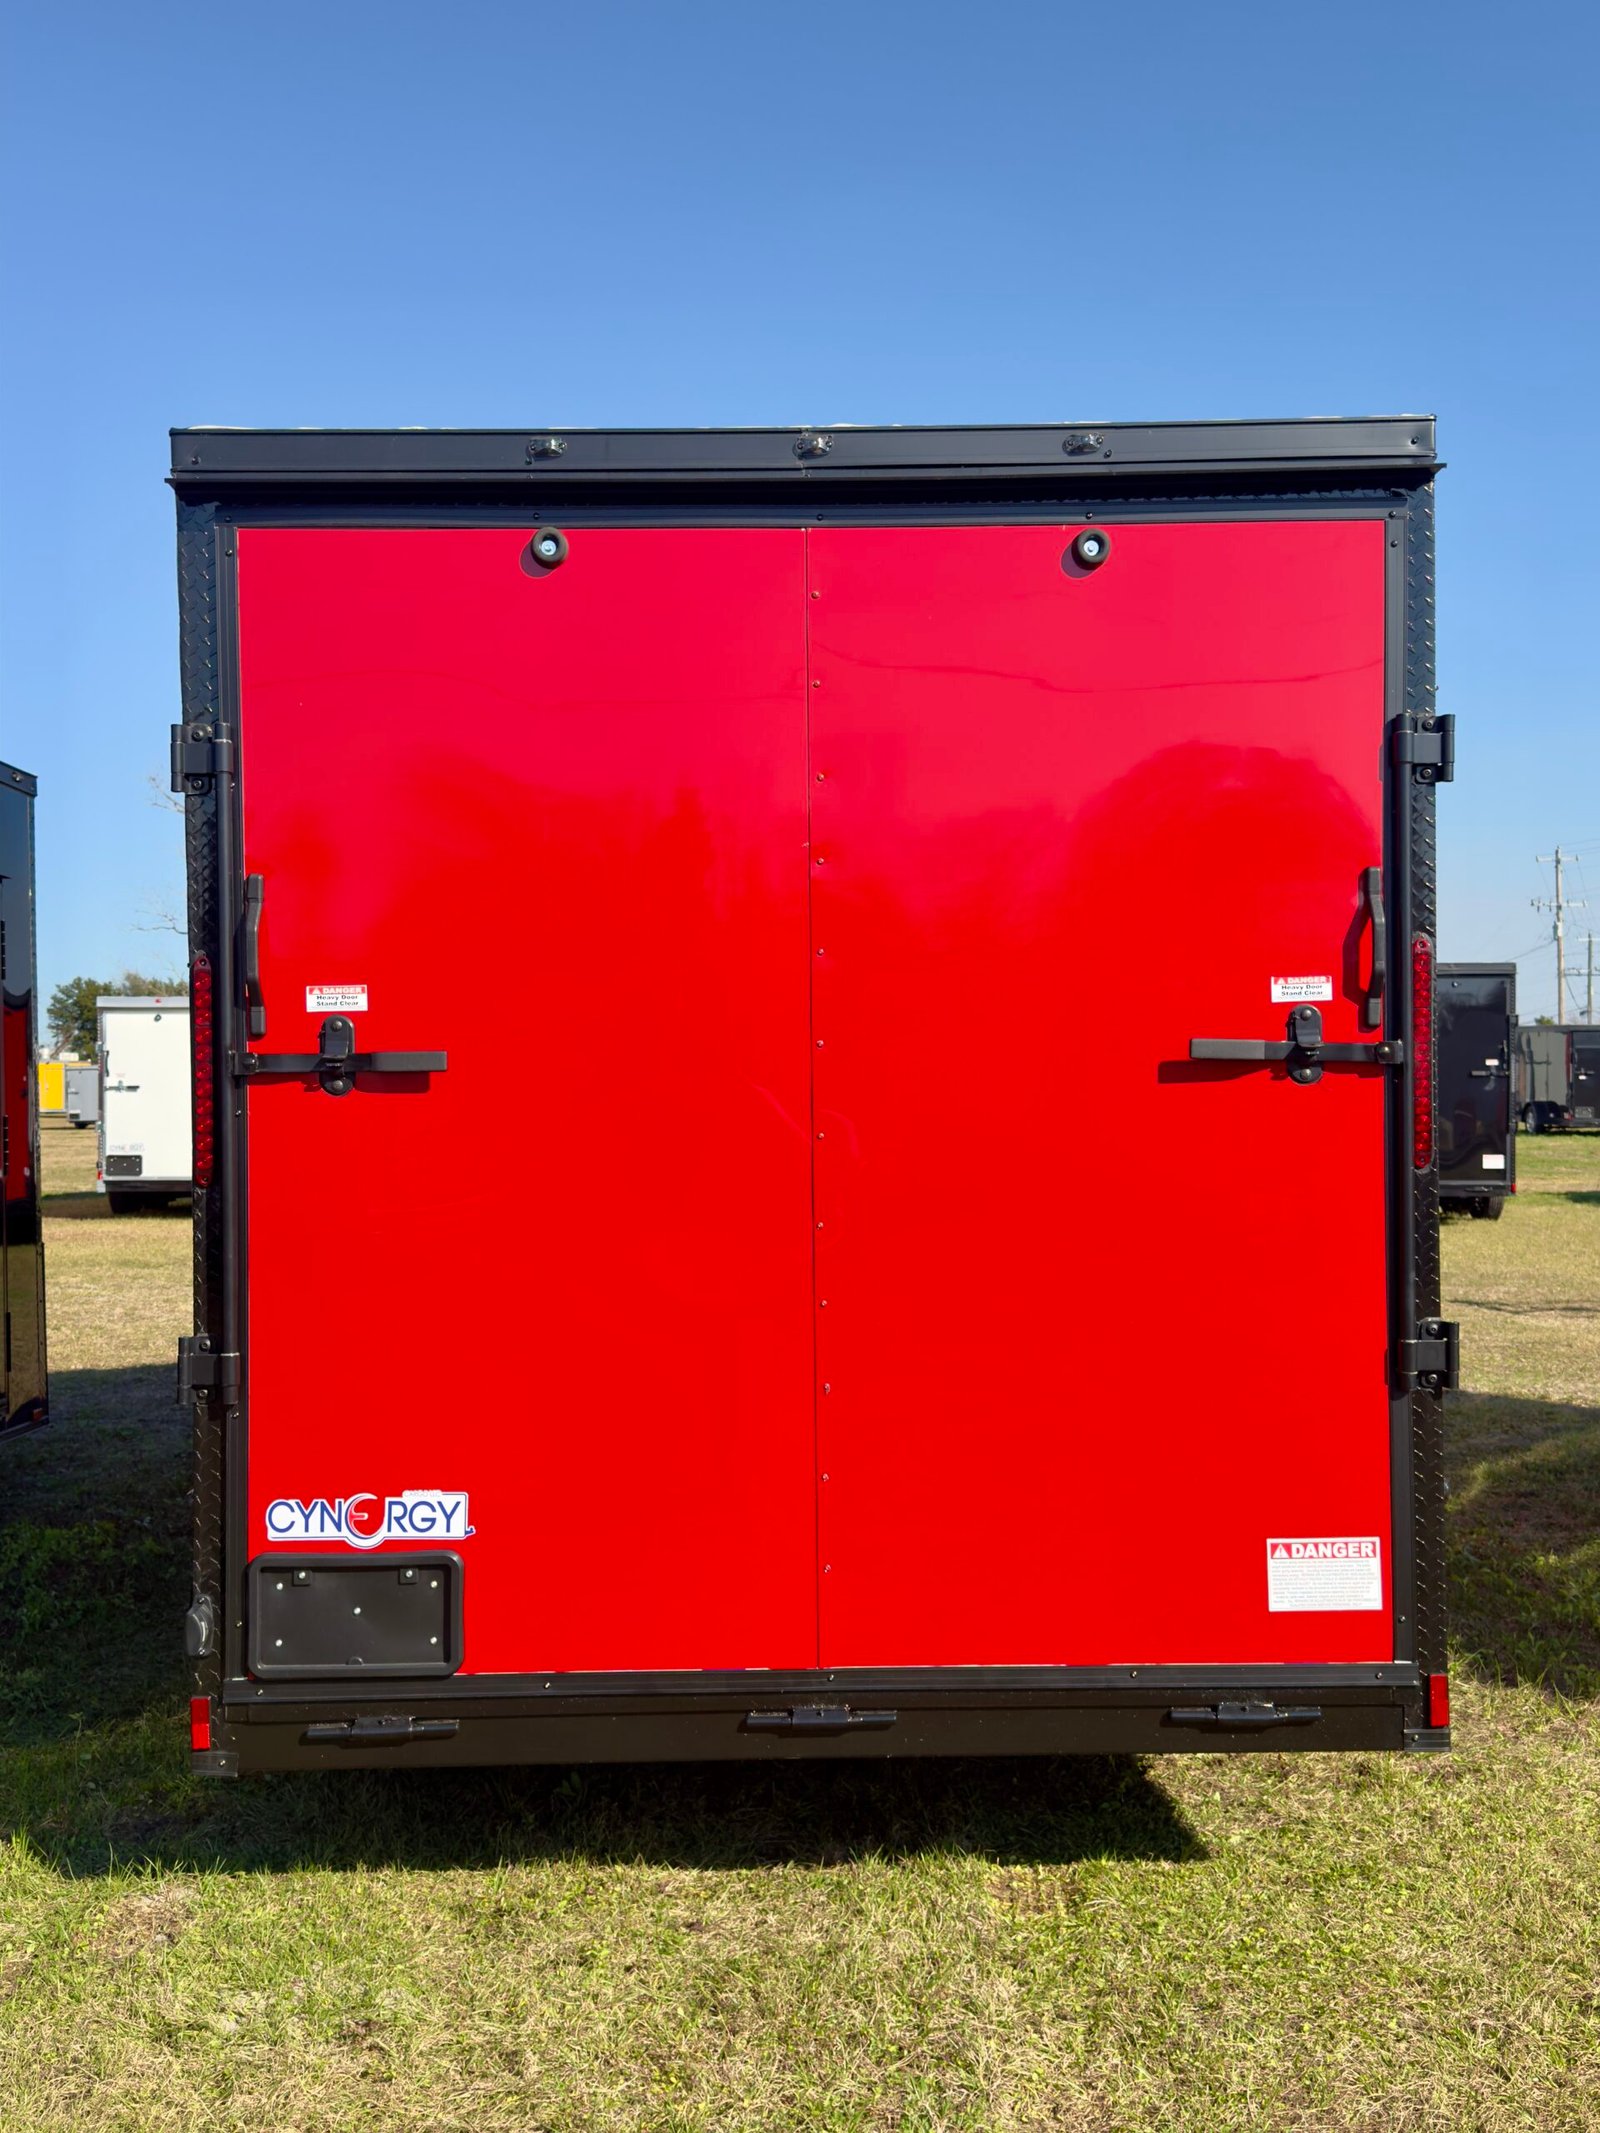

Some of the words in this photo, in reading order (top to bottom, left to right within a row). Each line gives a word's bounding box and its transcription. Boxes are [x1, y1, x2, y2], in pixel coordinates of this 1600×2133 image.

[1287, 976, 1327, 984] DANGER
[268, 1494, 461, 1540] CYNERGY
[1291, 1542, 1375, 1558] DANGER
